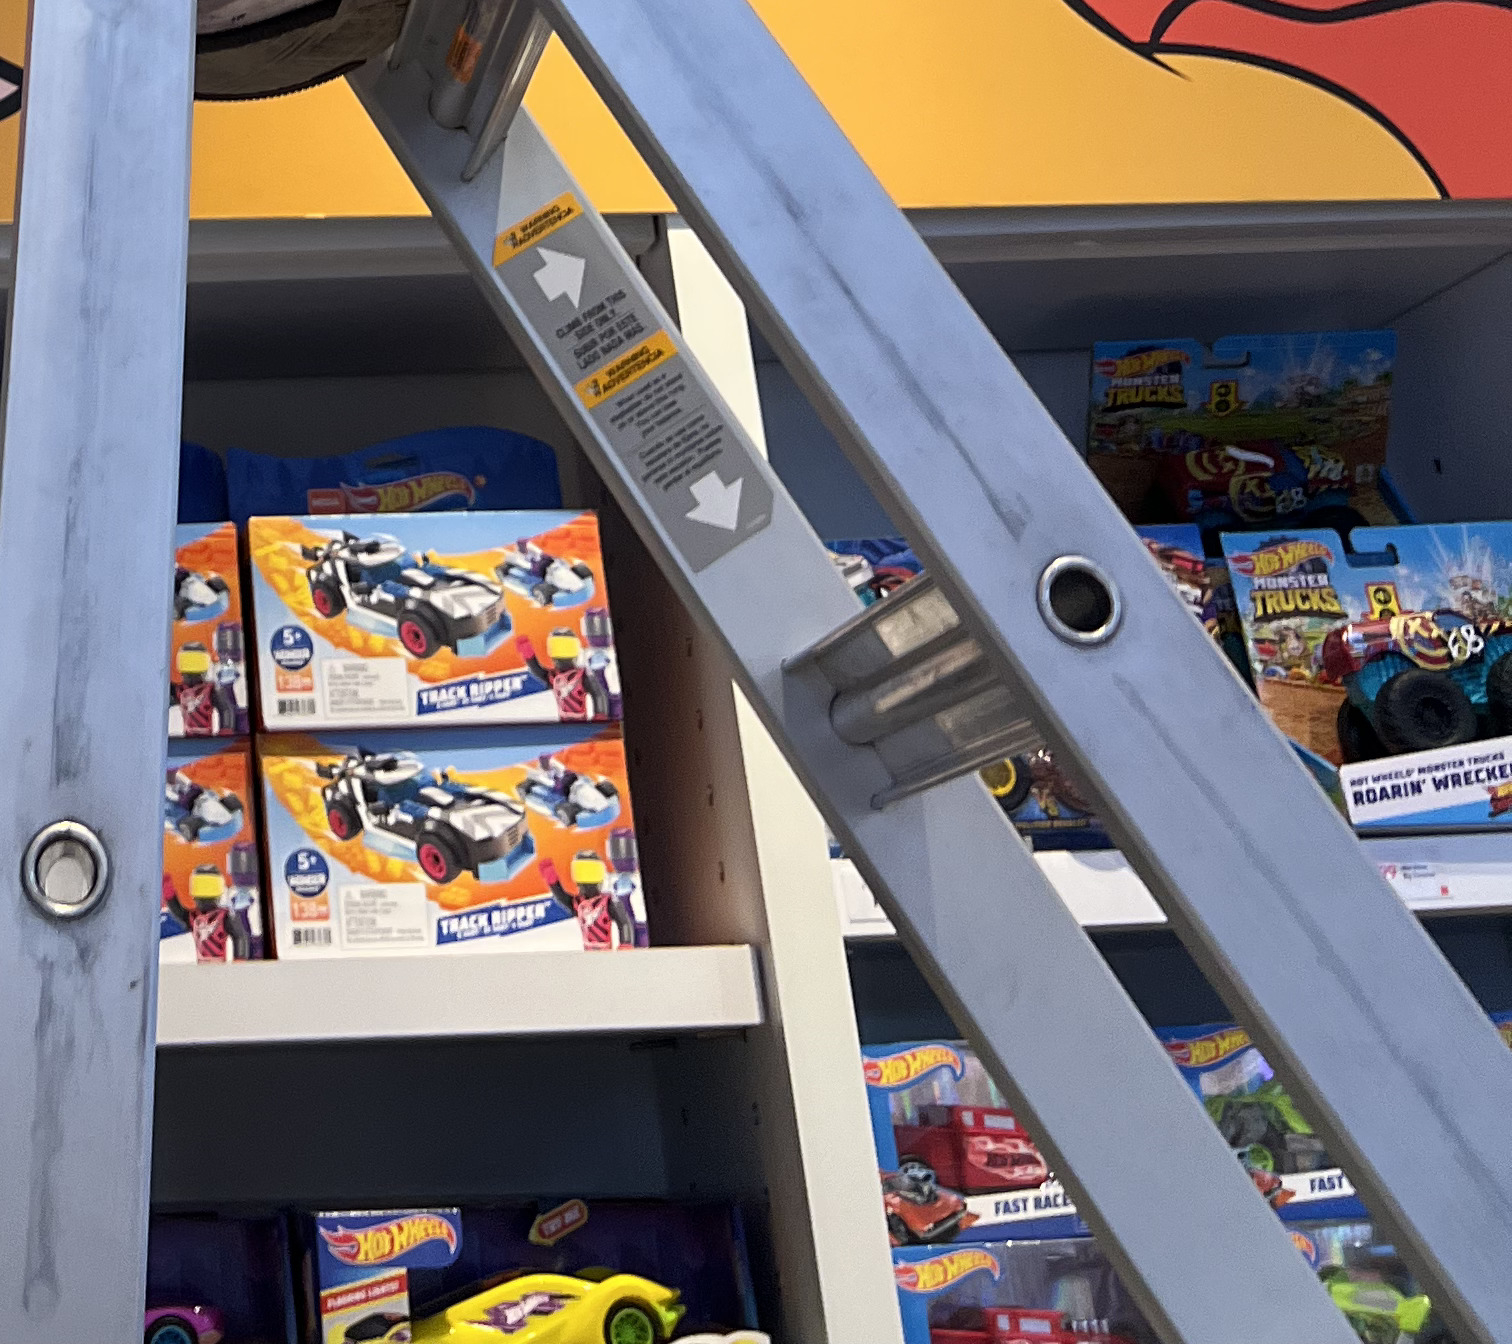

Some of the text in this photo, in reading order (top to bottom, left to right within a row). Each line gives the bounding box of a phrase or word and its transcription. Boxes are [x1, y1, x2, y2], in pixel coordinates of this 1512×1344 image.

[1107, 384, 1184, 407] TRUCKS
[1251, 541, 1327, 575] HOT WHEELS
[1252, 573, 1329, 590] MONSTER
[1252, 587, 1343, 618] TRUCKS
[419, 683, 468, 706] TRACK
[1417, 760, 1465, 774] MONSTER
[1352, 763, 1512, 806] ROARIN' WRECKE
[440, 911, 489, 935] TRACK
[882, 1061, 911, 1085] HOT
[1309, 1173, 1345, 1193] FAST
[994, 1193, 1071, 1216] FAST RACE
[356, 1217, 449, 1262] HOT WHEELS
